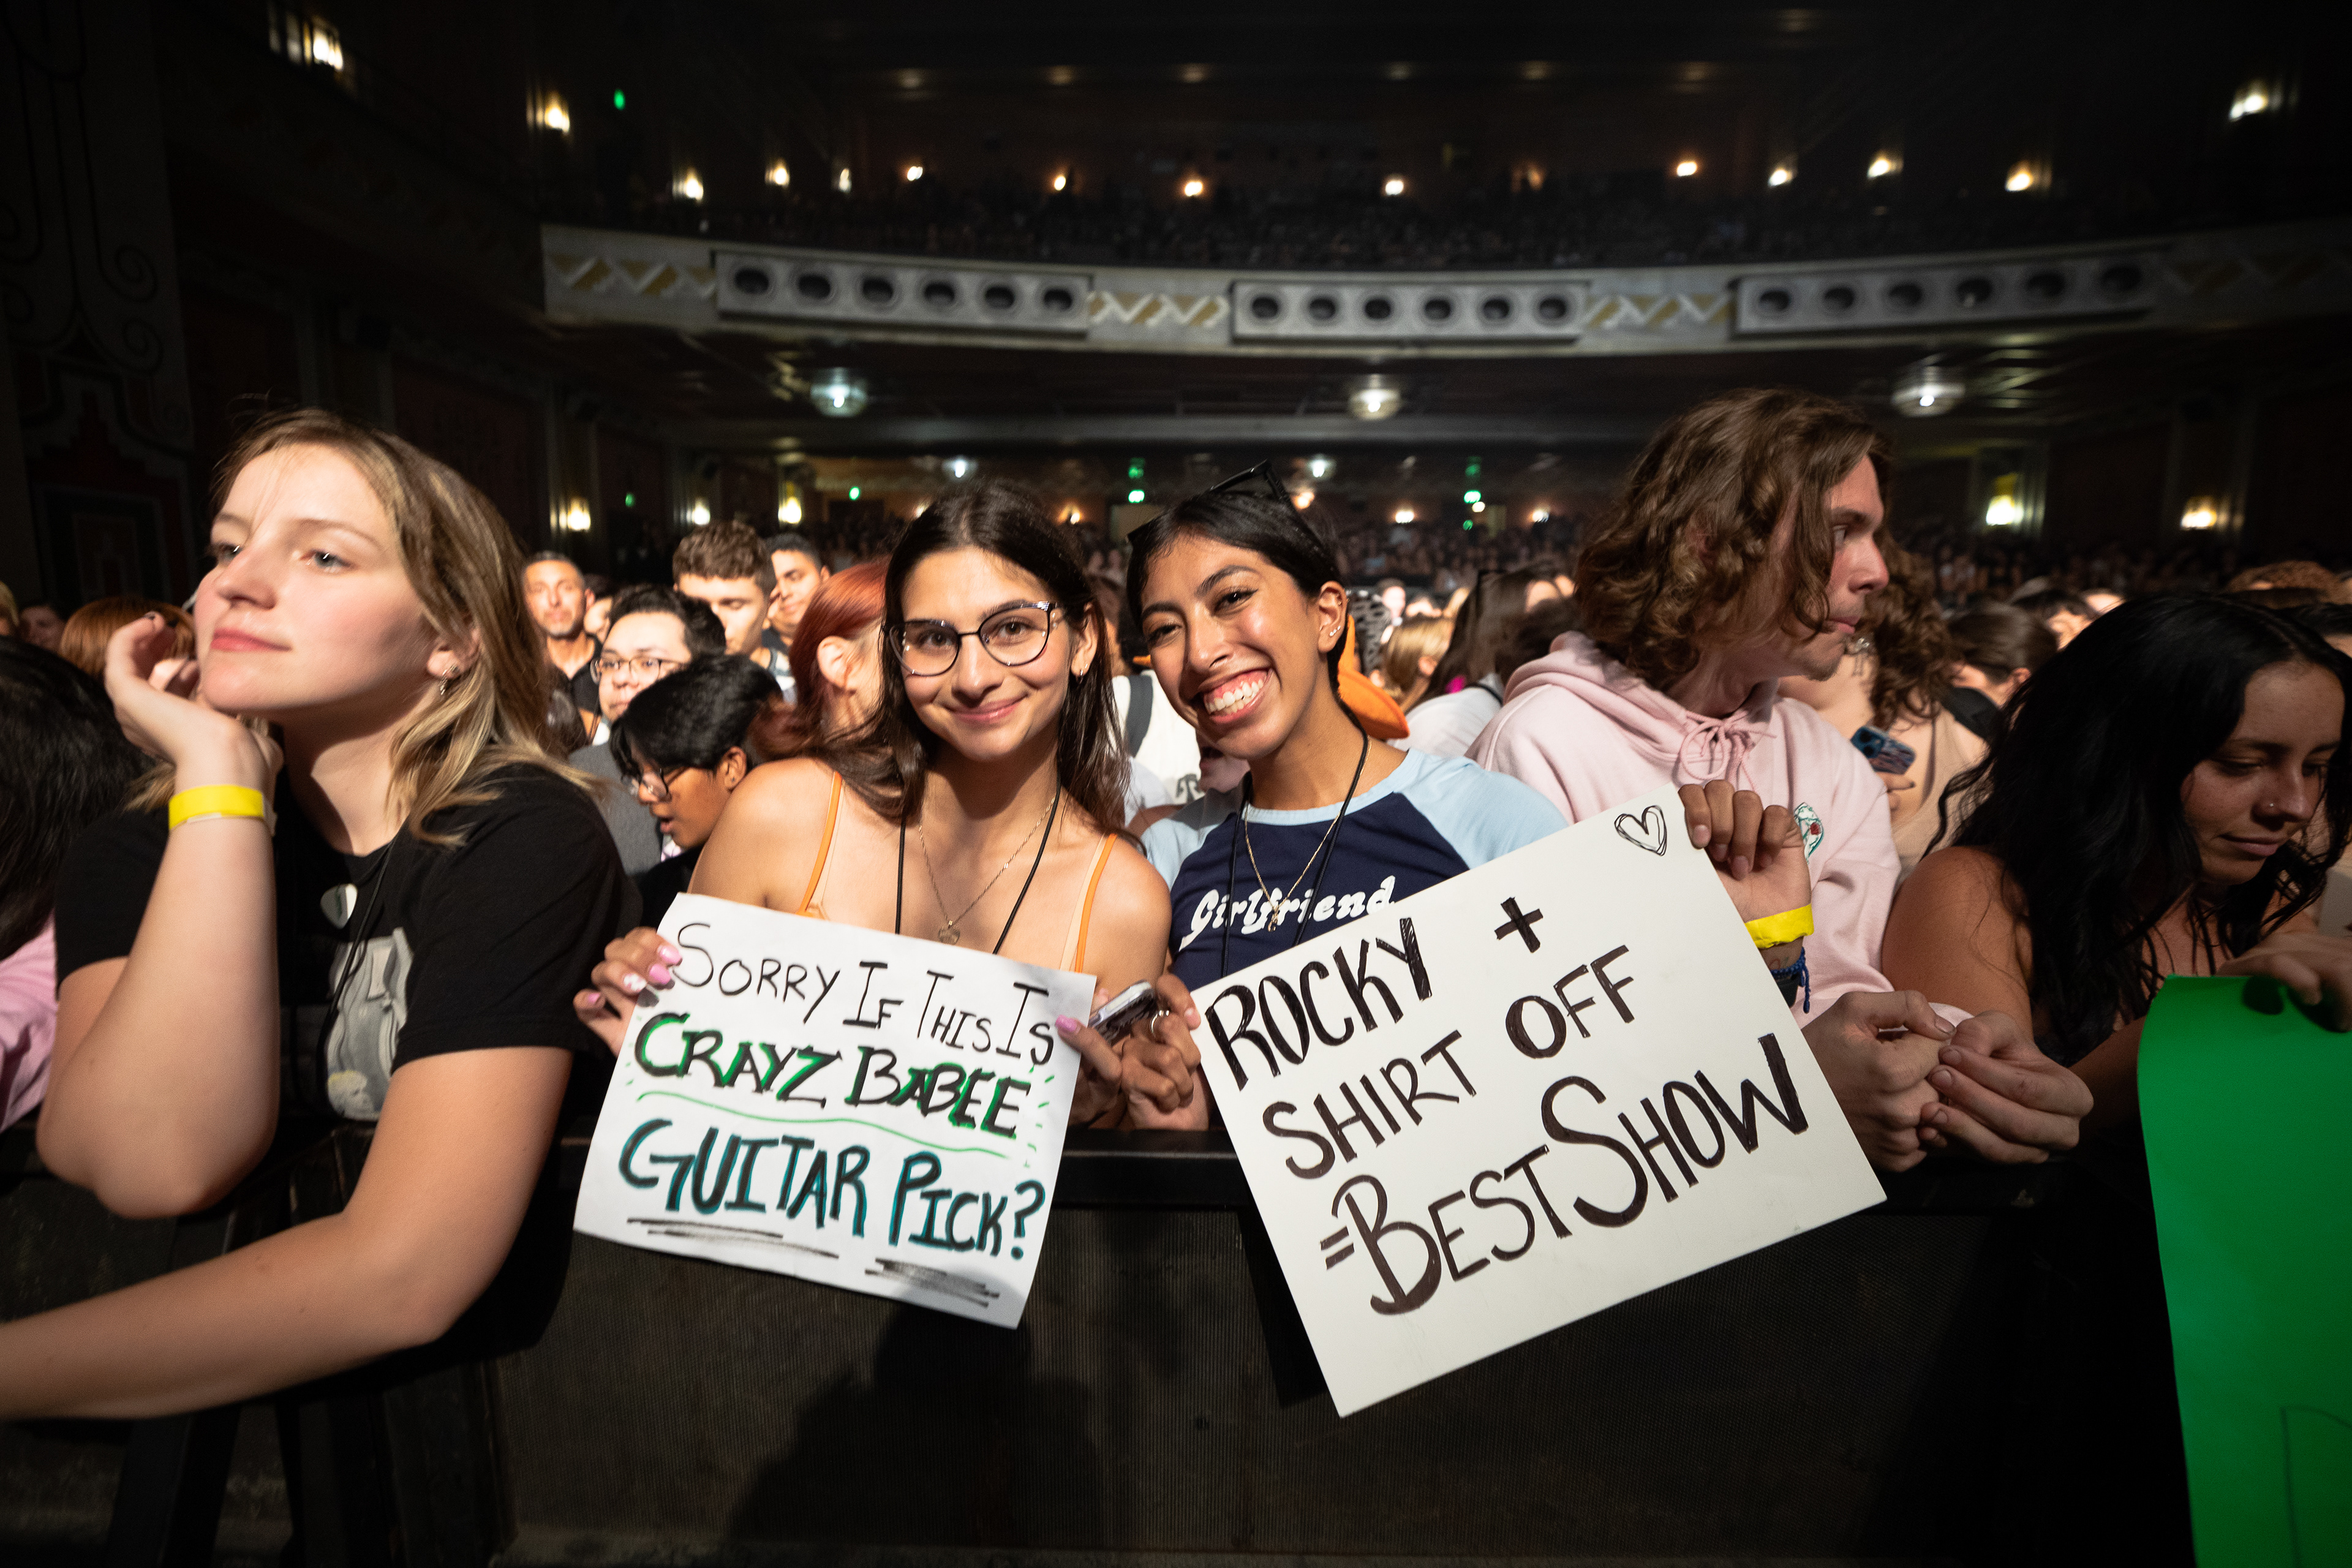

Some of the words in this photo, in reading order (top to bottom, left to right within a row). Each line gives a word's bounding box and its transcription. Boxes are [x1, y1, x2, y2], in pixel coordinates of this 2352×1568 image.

[1179, 875, 1395, 952] Girlfriend
[671, 922, 840, 1024] SORRY
[843, 962, 904, 1030] IF
[918, 970, 992, 1053] THIS
[995, 982, 1055, 1066] IS
[1205, 917, 1433, 1091] ROCKY
[1262, 1030, 1477, 1179] SHIRT
[1504, 944, 1634, 1058] OFF
[635, 1012, 843, 1109] CRAYZ
[845, 1046, 1031, 1139] BABEE
[619, 1118, 870, 1239] GUITAR
[888, 1151, 1046, 1261] PICK?
